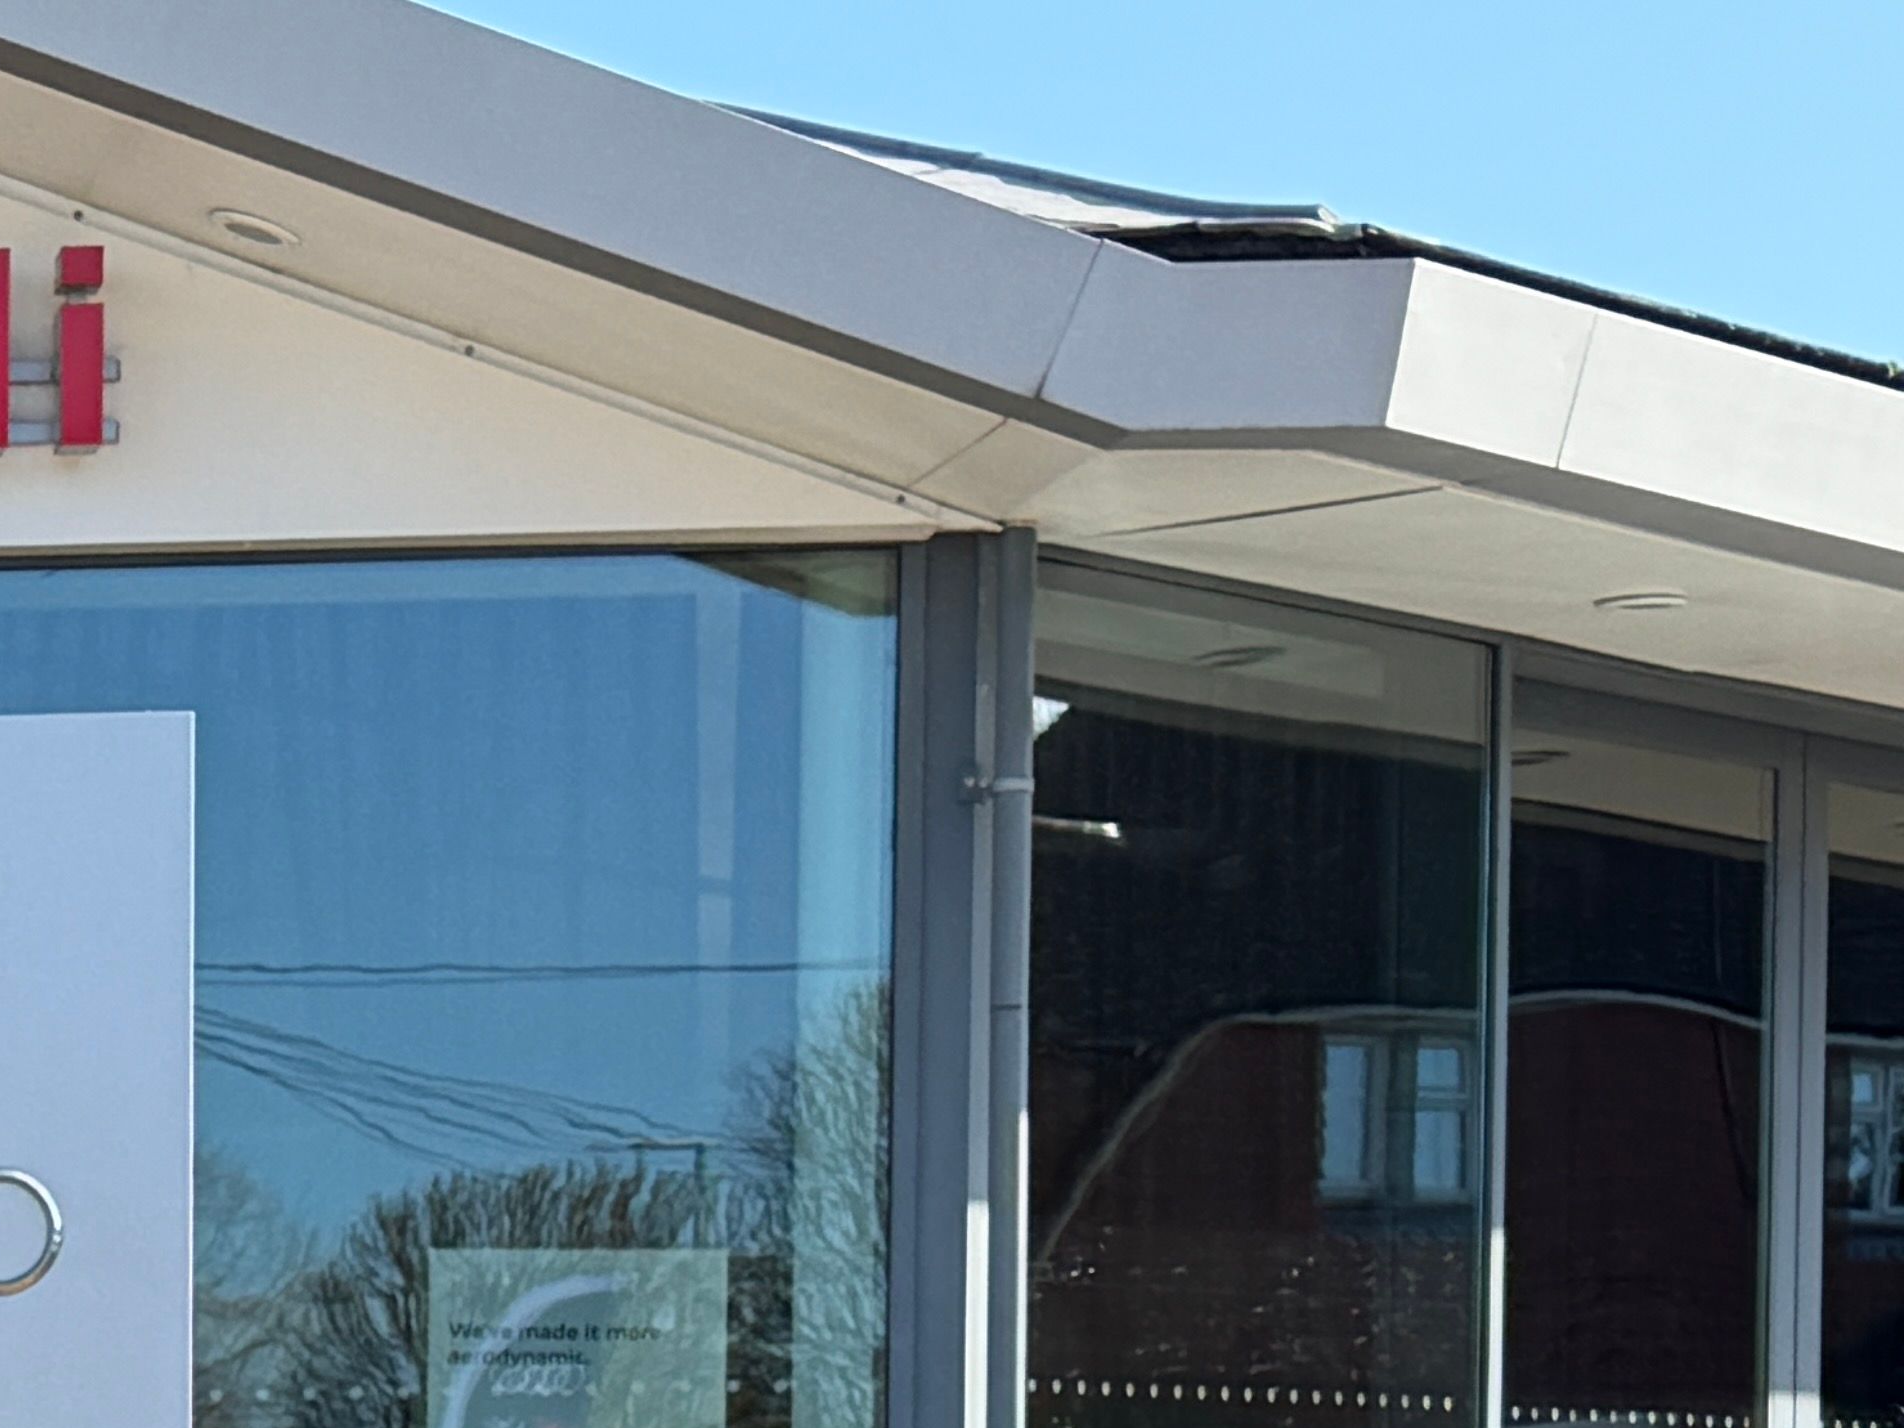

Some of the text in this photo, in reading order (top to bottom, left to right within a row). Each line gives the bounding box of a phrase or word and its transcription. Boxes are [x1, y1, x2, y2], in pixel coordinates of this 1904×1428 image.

[518, 1323, 579, 1341] made
[583, 1322, 600, 1341] it
[605, 1326, 662, 1341] more
